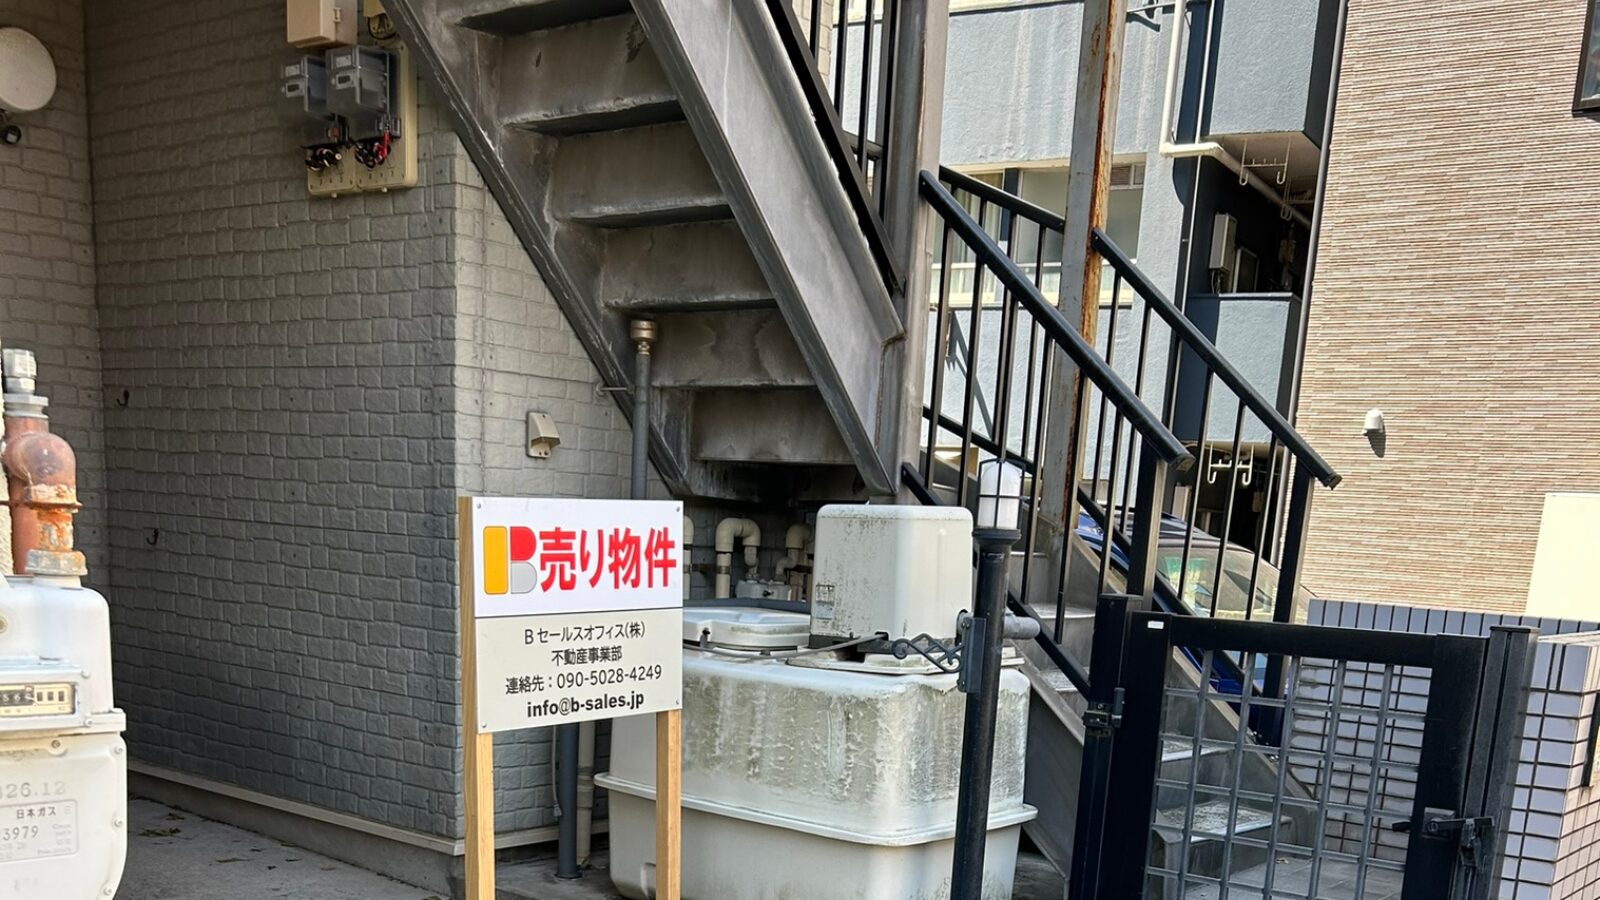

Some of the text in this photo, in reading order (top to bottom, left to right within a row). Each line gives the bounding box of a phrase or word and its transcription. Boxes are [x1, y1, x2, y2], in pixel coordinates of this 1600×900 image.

[539, 526, 678, 592] 売り物件
[551, 645, 623, 667] 不動産事業部
[527, 691, 645, 718] info@b-sales.jp
[16, 806, 57, 819] 日本ガス
